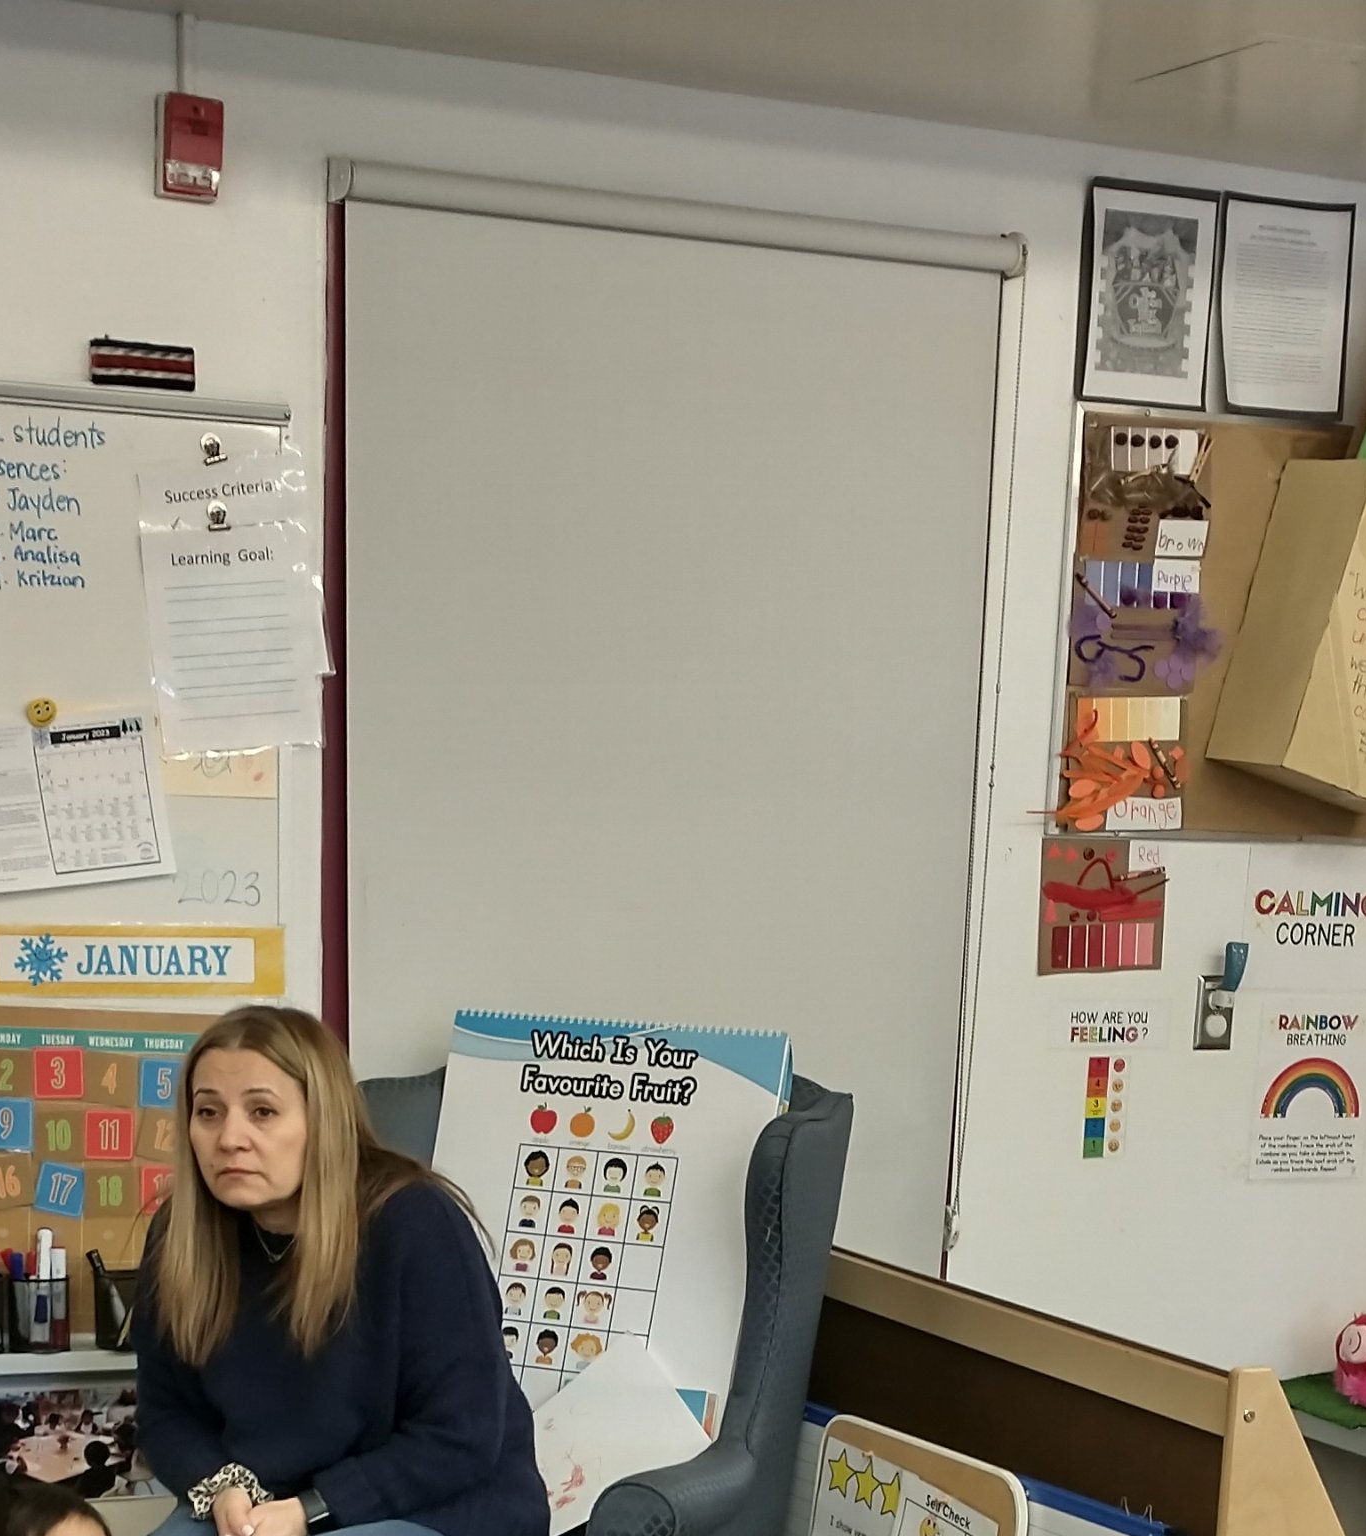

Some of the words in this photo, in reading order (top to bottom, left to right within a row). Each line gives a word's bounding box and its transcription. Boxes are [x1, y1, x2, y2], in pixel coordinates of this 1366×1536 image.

[13, 416, 106, 448] students
[7, 487, 80, 520] Jayden
[164, 487, 218, 504] Success
[9, 522, 57, 542] Marc
[170, 549, 231, 568] Learning
[237, 547, 274, 563] Goal:
[1139, 846, 1160, 865] Red
[177, 871, 261, 906] 2023
[1276, 922, 1355, 947] CORNER
[76, 943, 232, 978] JANUARY
[1070, 1011, 1099, 1024] HOW
[1102, 1011, 1124, 1024] ARE
[1127, 1011, 1149, 1024] YOU
[1278, 1014, 1359, 1031] RAINBOW
[41, 1034, 75, 1046] TUESDAY
[88, 1036, 134, 1048] WEDNESDAY
[144, 1038, 184, 1050] THURSDAY
[1070, 1026, 1139, 1043] FEELING
[1286, 1033, 1347, 1046] BREATHING
[532, 1030, 605, 1061] Which
[611, 1037, 637, 1063] Is
[645, 1039, 698, 1068] Your
[50, 1057, 65, 1089] 3
[101, 1063, 117, 1095] 4
[157, 1067, 172, 1100] 5
[521, 1065, 623, 1099] Favourite
[630, 1074, 696, 1104] Fruit?
[45, 1119, 72, 1151] 10
[99, 1118, 120, 1150] 11
[50, 1172, 78, 1205] 17
[97, 1175, 123, 1206] 18
[837, 1518, 852, 1533] show
[942, 1503, 972, 1529] Check
